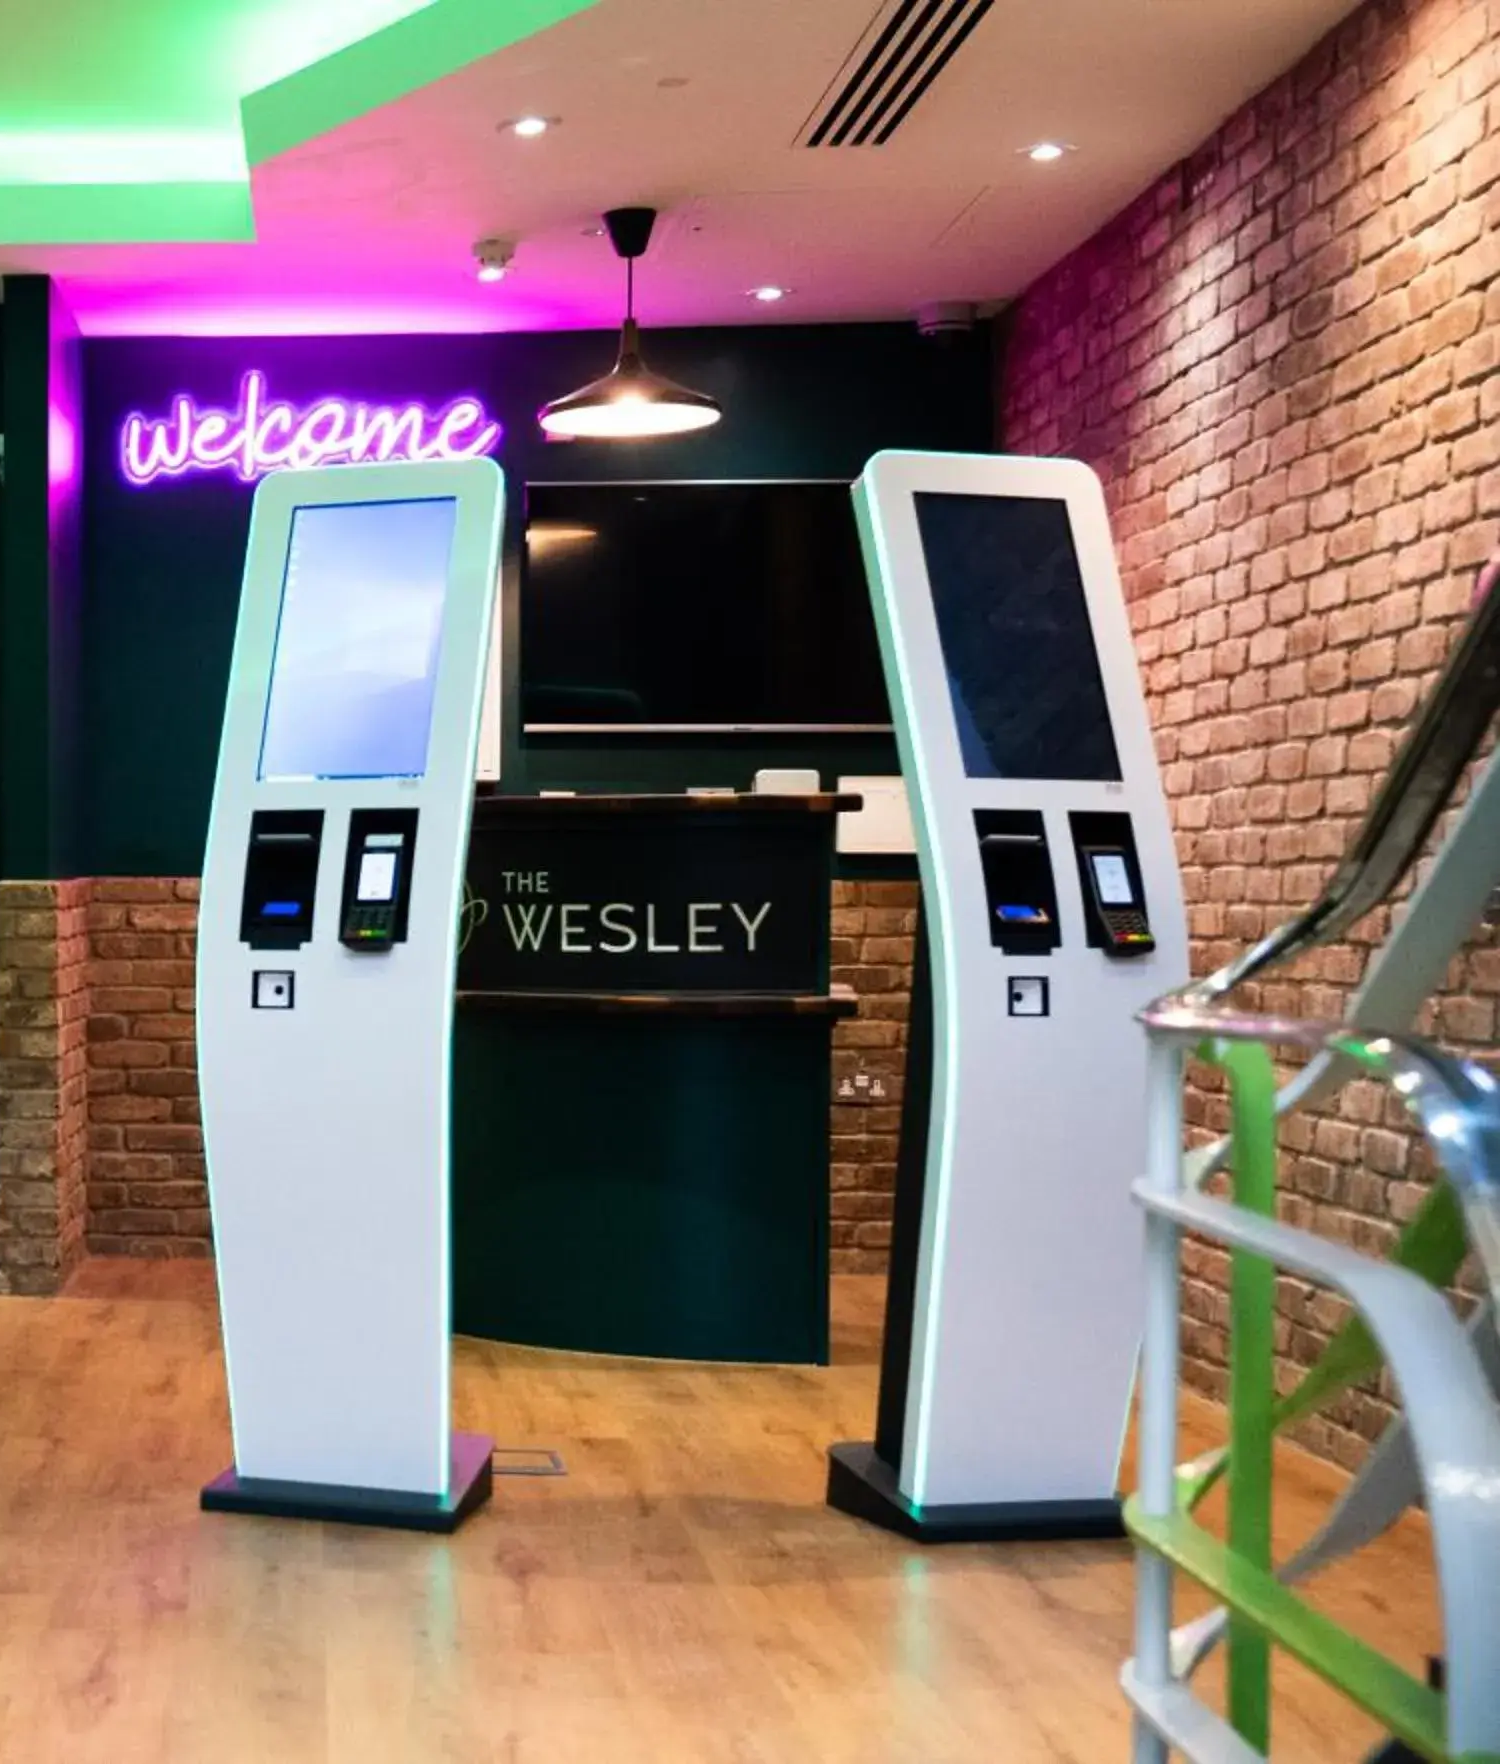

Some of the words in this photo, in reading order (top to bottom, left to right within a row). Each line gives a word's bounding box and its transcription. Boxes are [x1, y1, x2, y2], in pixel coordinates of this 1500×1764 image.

[125, 371, 500, 481] welcome
[501, 871, 549, 893] THE
[502, 901, 772, 952] WESLEY
